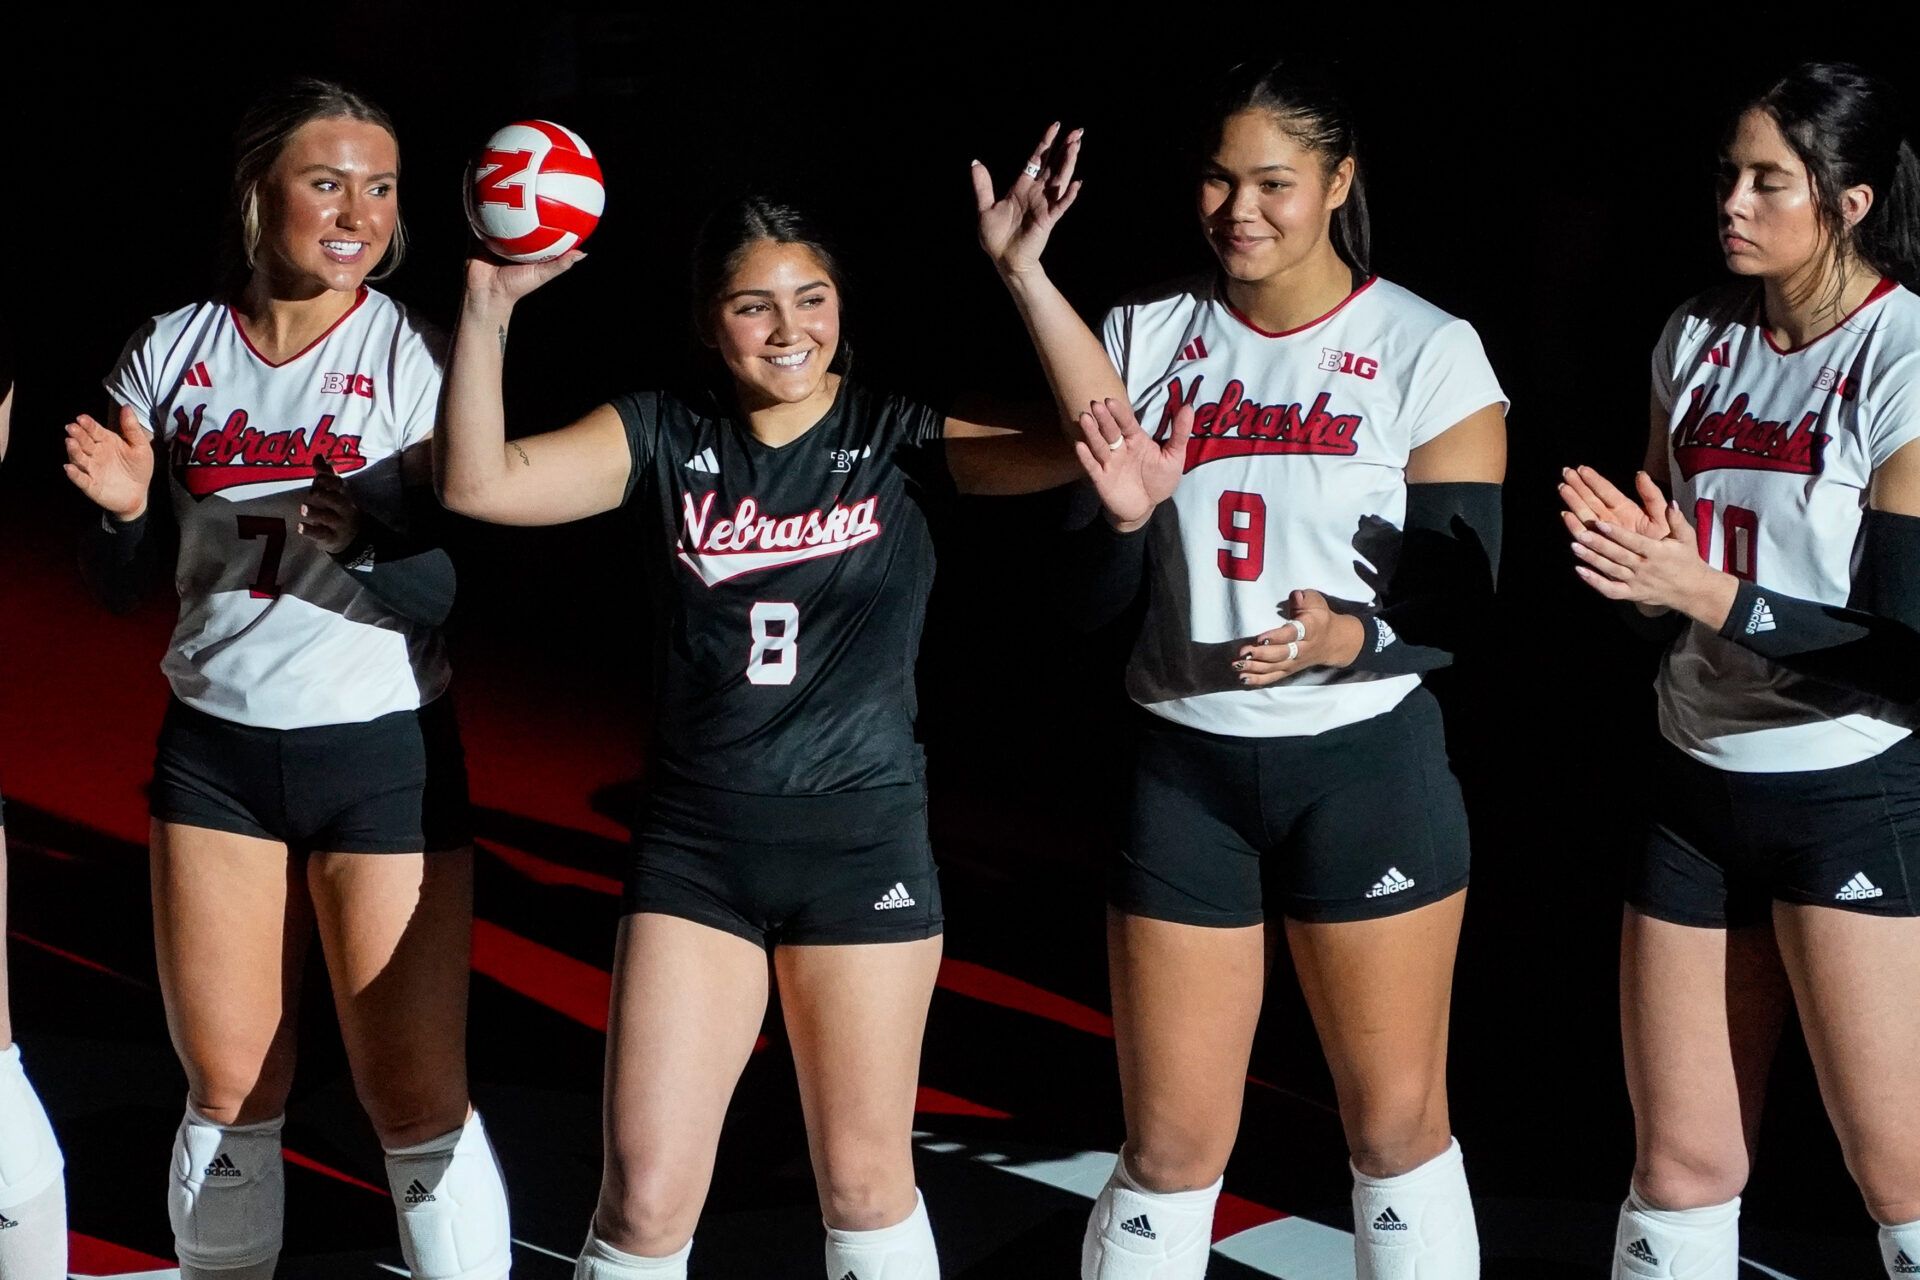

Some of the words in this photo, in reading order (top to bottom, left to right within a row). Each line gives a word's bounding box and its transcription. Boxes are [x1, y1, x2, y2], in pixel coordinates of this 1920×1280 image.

[474, 146, 536, 210] N
[1153, 375, 1362, 447] Nebraska
[172, 403, 362, 466] Nebraska
[677, 489, 880, 554] Nebraska
[1217, 489, 1267, 582] 9
[1694, 497, 1759, 583] 10
[236, 514, 287, 600] 7
[1745, 597, 1766, 636] adidas
[746, 601, 799, 685] 8
[874, 898, 916, 911] adidas
[1365, 878, 1416, 899] adidas
[1835, 887, 1884, 901] adidas
[204, 1167, 242, 1177] adidas
[404, 1193, 436, 1204] adidas
[1120, 1222, 1157, 1241] adidas
[1373, 1221, 1408, 1231] adidas
[1627, 1246, 1658, 1266] adidas
